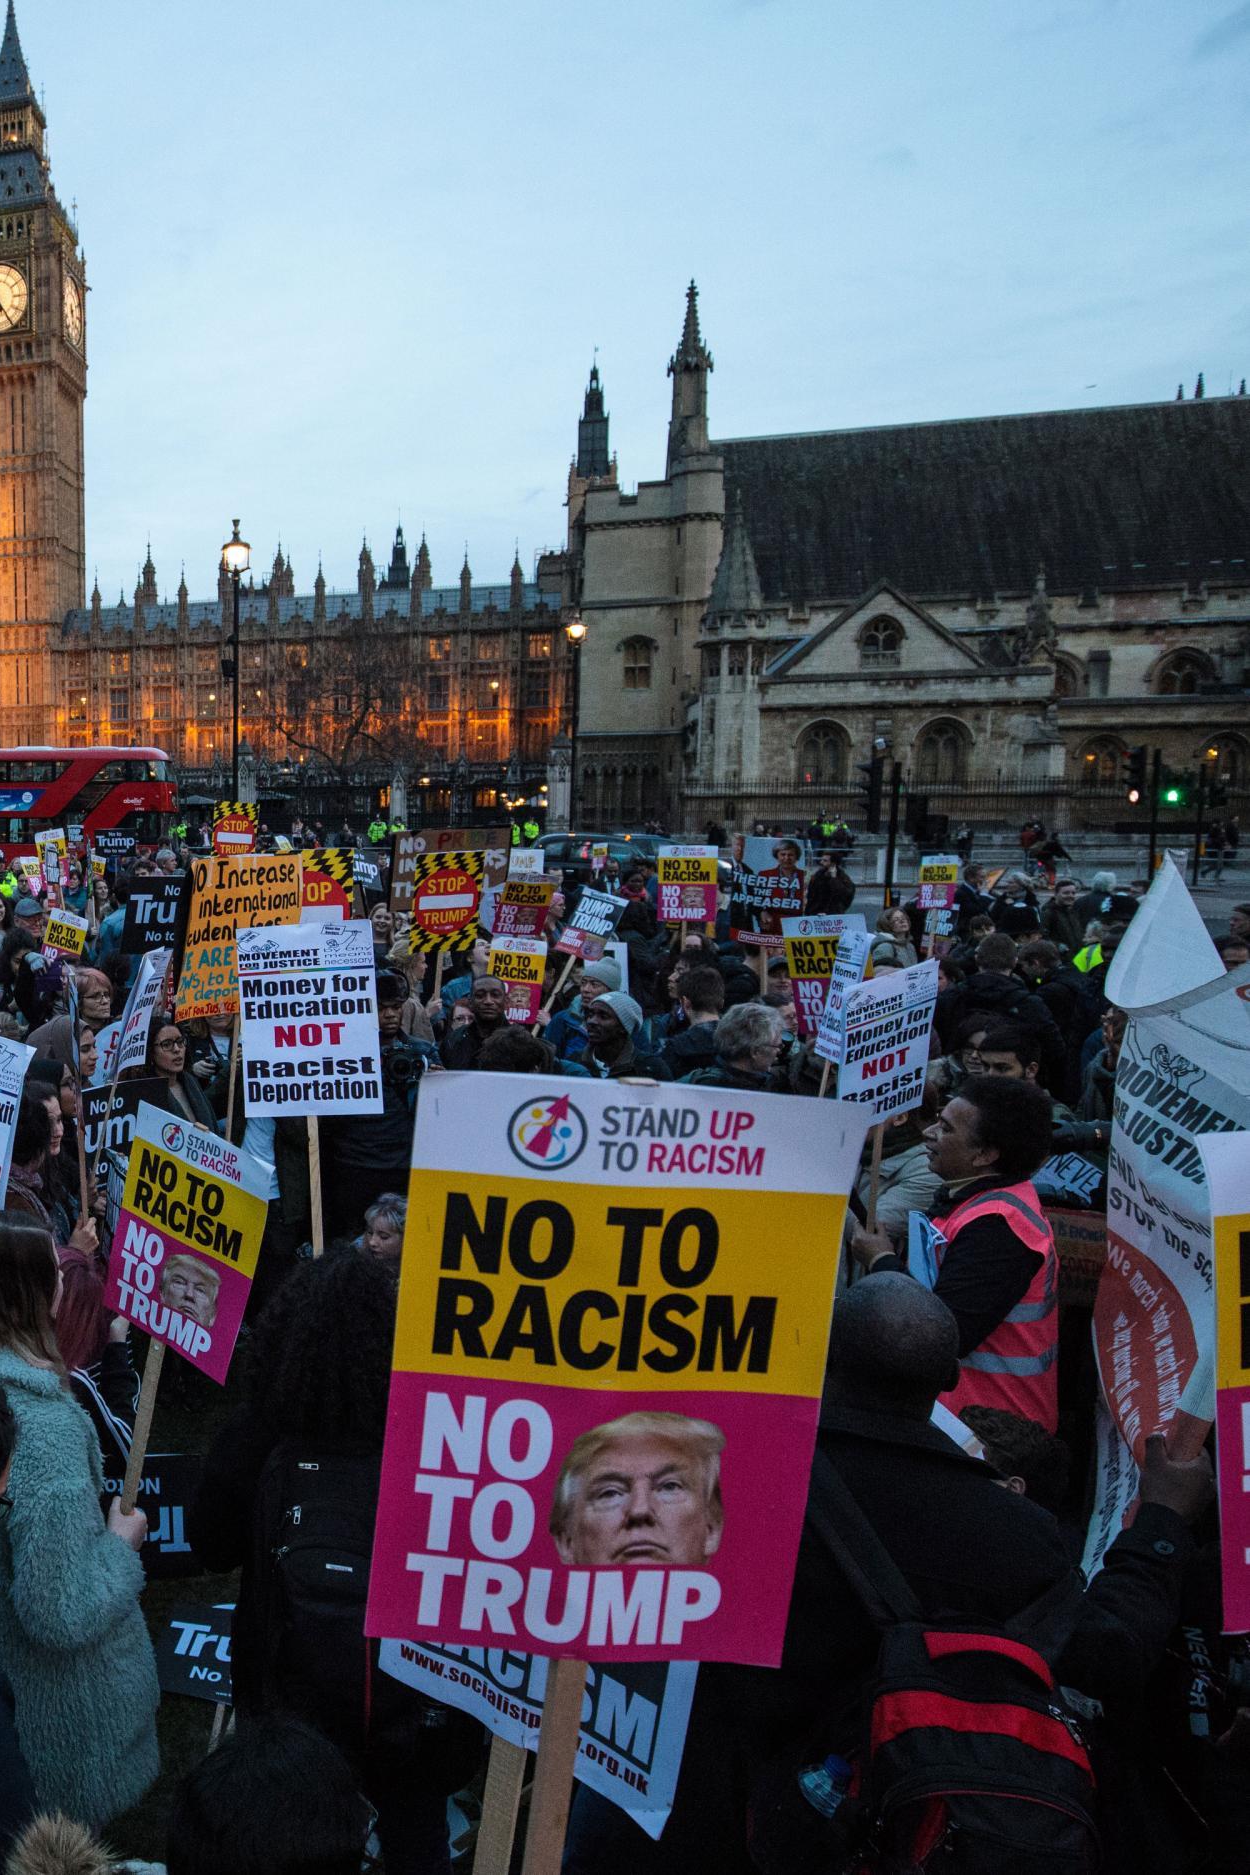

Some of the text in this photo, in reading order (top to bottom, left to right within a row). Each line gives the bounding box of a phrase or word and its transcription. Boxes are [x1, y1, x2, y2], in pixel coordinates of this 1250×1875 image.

[223, 820, 249, 832] STOP
[95, 835, 135, 849] Trump
[215, 860, 295, 889] Increase
[663, 860, 701, 870] NO TO
[427, 876, 467, 894] STOP
[663, 871, 710, 882] RACISM
[733, 871, 801, 890] THERESA
[164, 884, 180, 896] No
[199, 875, 300, 919] international
[505, 893, 546, 904] RACISM
[507, 883, 541, 894] NO TO
[662, 885, 680, 897] NO
[753, 887, 773, 897] THE
[502, 904, 517, 914] NO
[578, 896, 614, 918] DUMP
[662, 896, 679, 908] TO
[732, 893, 801, 910] APPEASER
[424, 909, 469, 925] TRUMP
[500, 913, 514, 923] TO
[571, 911, 613, 936] TRUMP
[662, 907, 707, 919] TRUMP
[51, 922, 77, 938] NO TO
[145, 931, 161, 942] No
[497, 922, 536, 934] TRUMP
[48, 933, 79, 951] RACISM
[791, 941, 822, 957] NO
[198, 946, 234, 967] ARE
[239, 948, 320, 961] MOVEMENT
[262, 957, 321, 969] JUSTICE
[494, 953, 531, 968] NO TO
[493, 966, 538, 981] RACISM
[242, 974, 370, 998] Money for
[798, 981, 823, 1000] NO
[244, 997, 373, 1020] Education
[800, 999, 824, 1016] TO
[846, 993, 904, 1018] MOVEMENT
[863, 1002, 904, 1021] JUSTICE
[274, 1022, 345, 1048] NOT
[847, 1013, 904, 1048] Money
[907, 1005, 932, 1024] for
[845, 1022, 930, 1065] Education
[247, 1056, 376, 1079] Racist
[861, 1047, 911, 1080] NOT
[248, 1078, 379, 1104] Deportation
[842, 1066, 924, 1103] Racist
[600, 1105, 756, 1139] STAND UP
[187, 1134, 238, 1165] STAND UP
[598, 1141, 765, 1176] TO RACISM
[185, 1149, 242, 1182] TO RACISM
[1110, 1145, 1136, 1191] END
[138, 1148, 225, 1217] NO TO
[133, 1180, 243, 1262] RACISM
[1110, 1187, 1156, 1232] STOP
[1162, 1225, 1190, 1260] the
[123, 1220, 165, 1266] NO
[439, 1191, 720, 1288] NO TO
[120, 1250, 155, 1295] TO
[116, 1279, 212, 1359] TRUMP
[431, 1277, 778, 1374] RACISM
[418, 1392, 553, 1482] NO
[414, 1474, 536, 1560] TO
[405, 1553, 722, 1647] TRUMP
[189, 1665, 223, 1682] No
